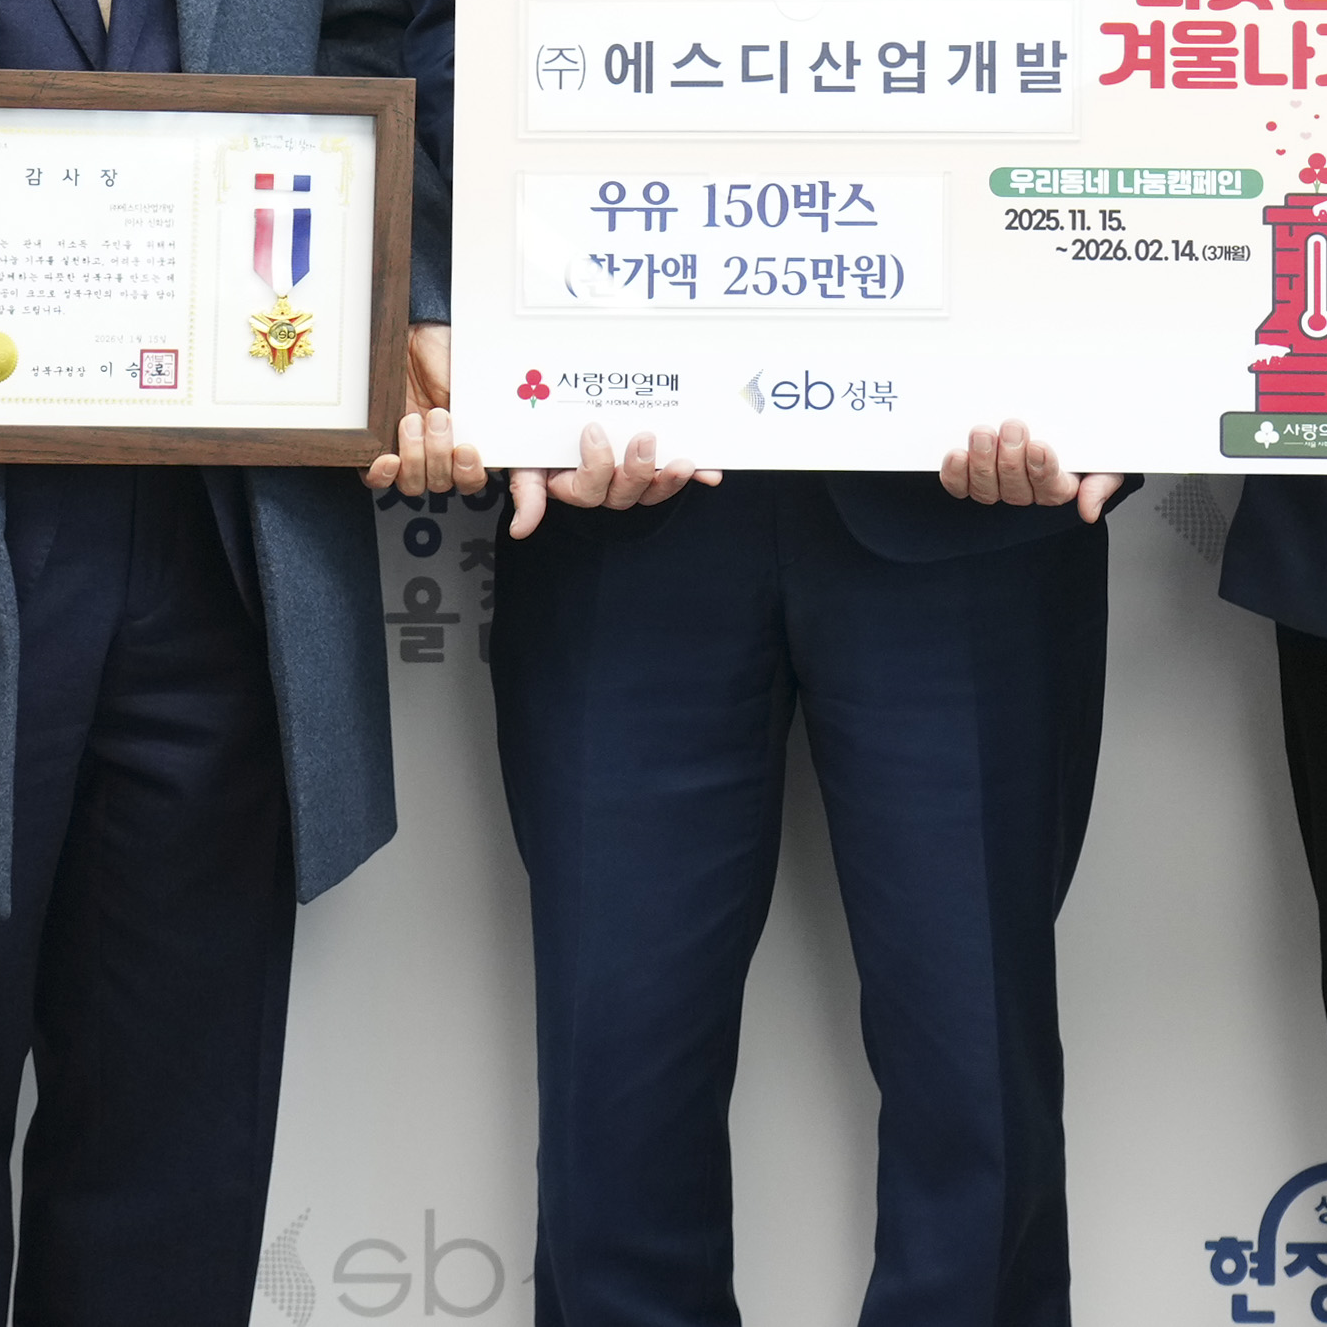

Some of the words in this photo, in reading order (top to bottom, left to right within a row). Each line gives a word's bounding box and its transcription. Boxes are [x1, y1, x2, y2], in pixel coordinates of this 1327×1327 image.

[1009, 169, 1110, 195] 우리동네
[1117, 169, 1243, 196] 나눔캠페인
[590, 180, 679, 233] 우유
[702, 180, 879, 233] 150박스
[723, 253, 905, 301] 255만원)
[556, 372, 679, 397] 사랑의열매
[771, 370, 835, 411] sb
[841, 379, 899, 413] 성북
[333, 1208, 505, 1318] sb
